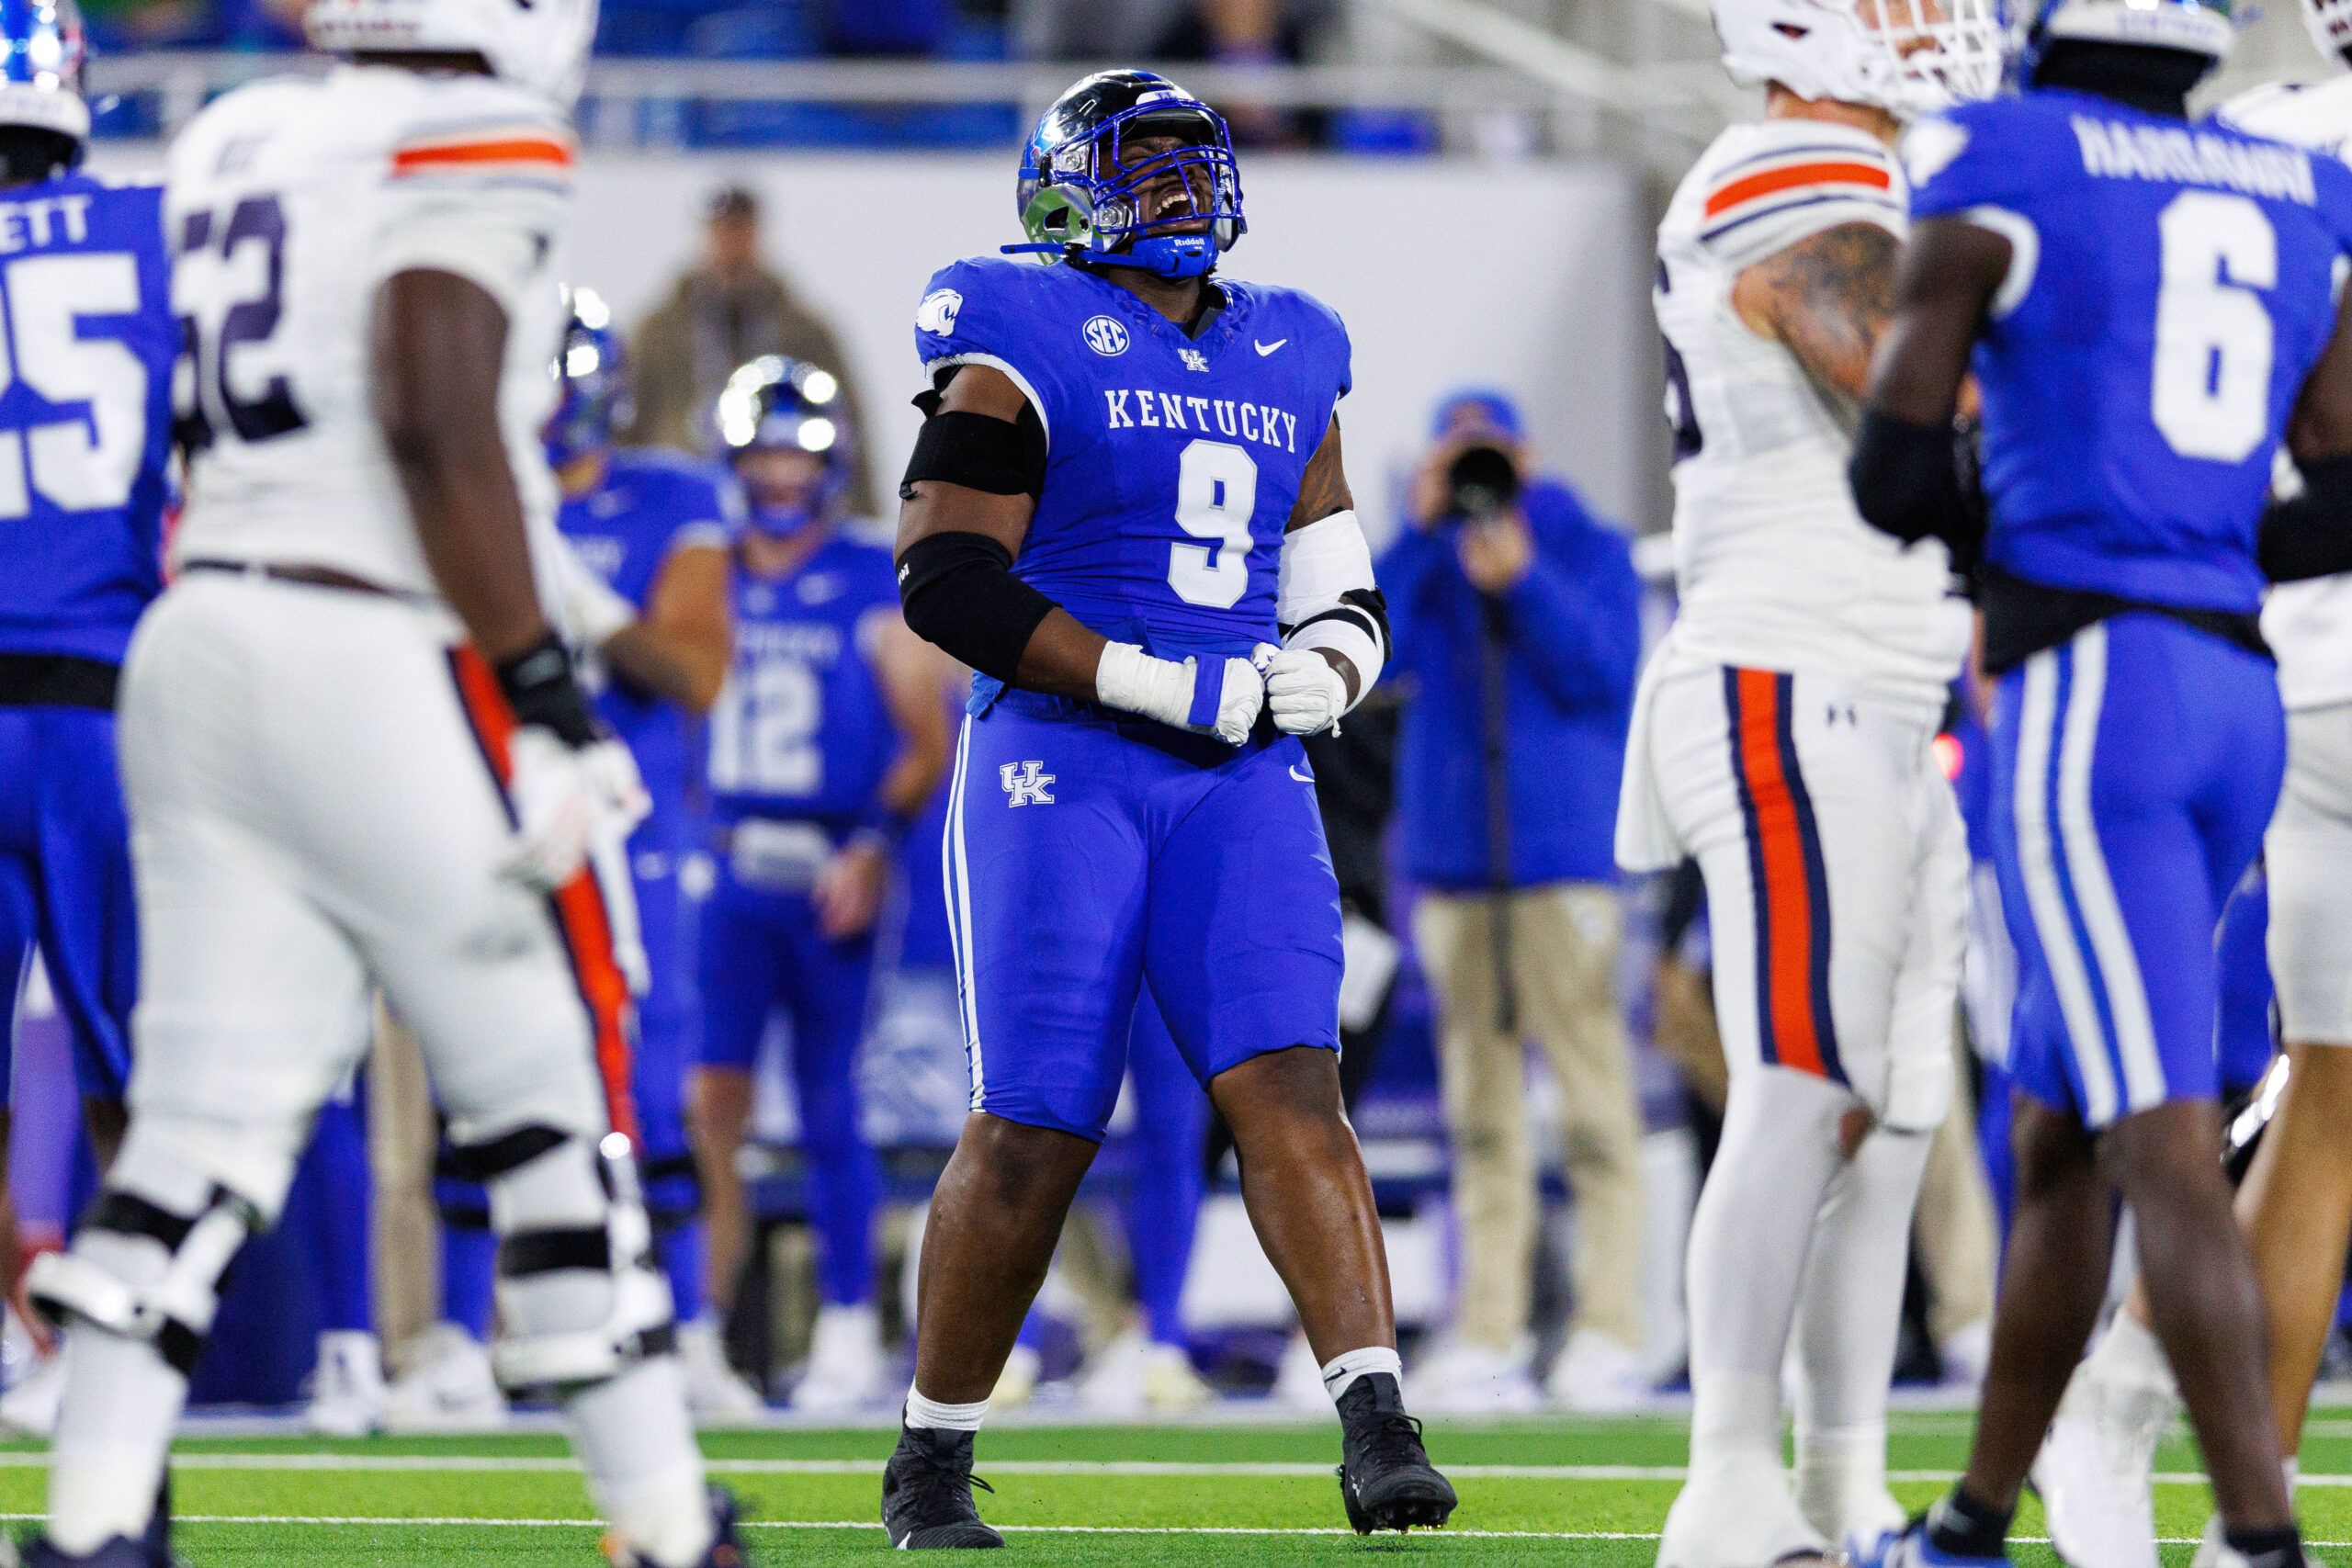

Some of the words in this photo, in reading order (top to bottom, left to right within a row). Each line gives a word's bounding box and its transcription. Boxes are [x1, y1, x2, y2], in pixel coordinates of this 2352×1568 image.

[1173, 237, 1205, 247] Riddell
[1086, 318, 1127, 355] SEC
[2151, 188, 2277, 464] 6
[0, 252, 150, 522] 5
[1104, 389, 1297, 454] KENTUCKY
[1167, 438, 1259, 610] 9
[707, 663, 825, 797] 12
[1000, 761, 1056, 808] UK
